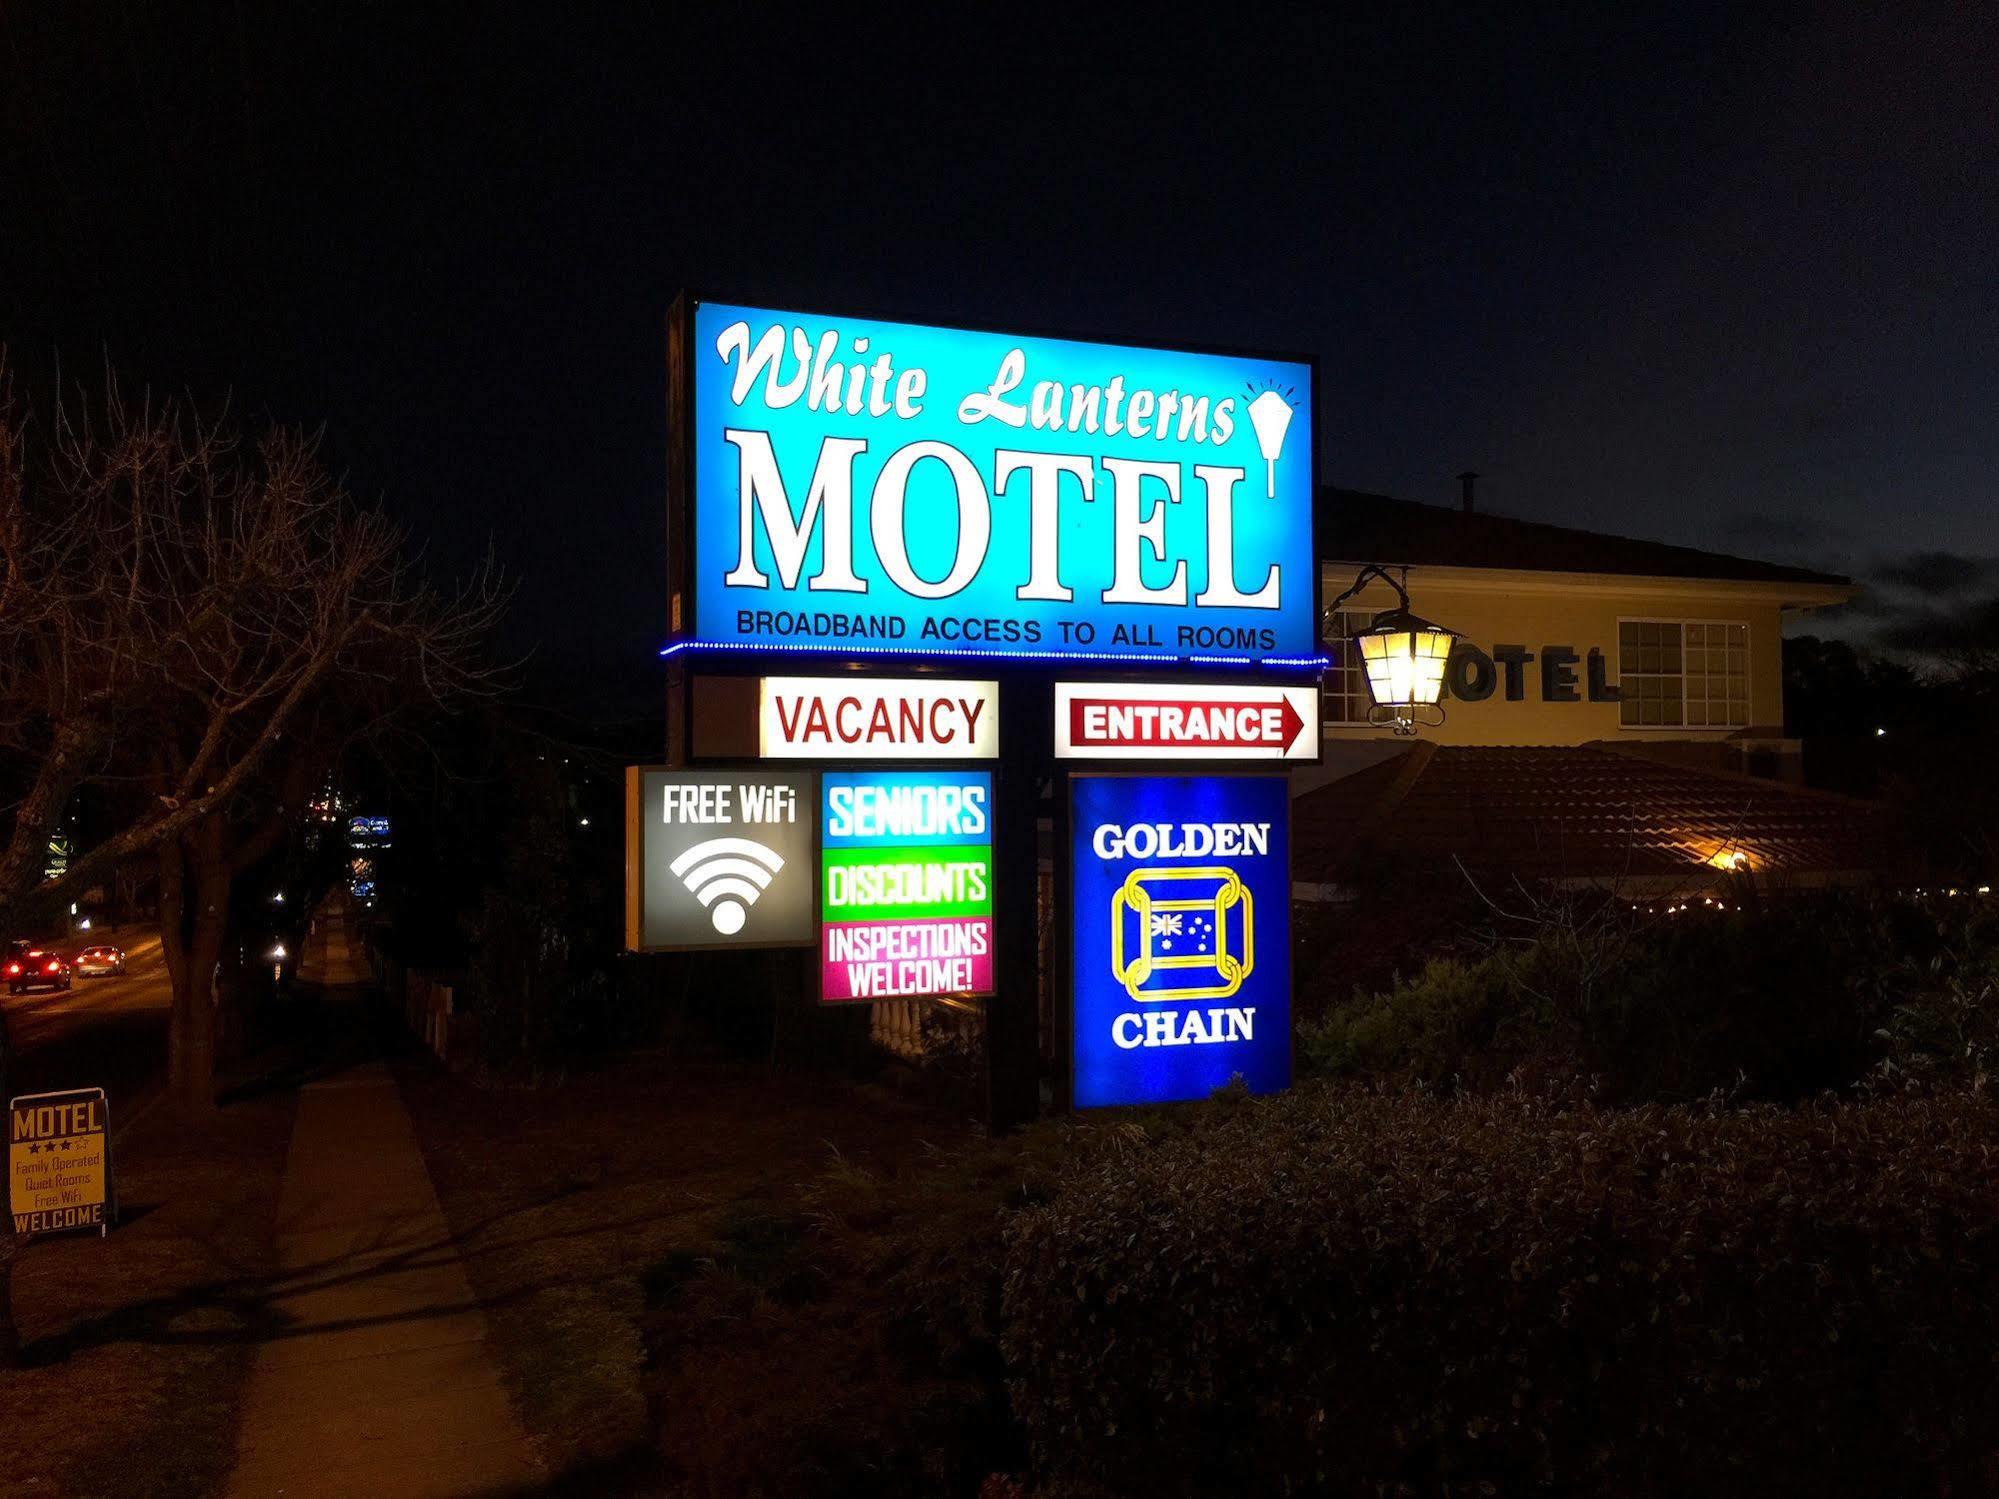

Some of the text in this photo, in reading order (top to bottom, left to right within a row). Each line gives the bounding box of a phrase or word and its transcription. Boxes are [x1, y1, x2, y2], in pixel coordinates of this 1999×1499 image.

[717, 321, 1236, 446] White Lanterns
[723, 429, 1281, 610] MOTEL
[738, 611, 1276, 651] BROADBAND ACCESS TO ALL ROOMS
[1438, 643, 1622, 702] OTEL
[776, 696, 985, 744] VACANCY
[1084, 706, 1284, 741] ENTRANCE
[662, 785, 796, 824] FREE WiFi
[828, 786, 986, 836] SENIORS
[1093, 823, 1271, 860] GOLDEN
[828, 863, 987, 907] DISCOUNTS
[829, 923, 987, 962] INSPECTIONS
[848, 958, 973, 997] WELCOME!
[1112, 1008, 1256, 1049] CHAIN
[14, 1103, 102, 1141] MOTEL
[16, 1152, 100, 1175] Family Operated
[25, 1173, 91, 1191] Quiet Rooms
[14, 1204, 102, 1234] WELCOME
[35, 1193, 58, 1208] Free
